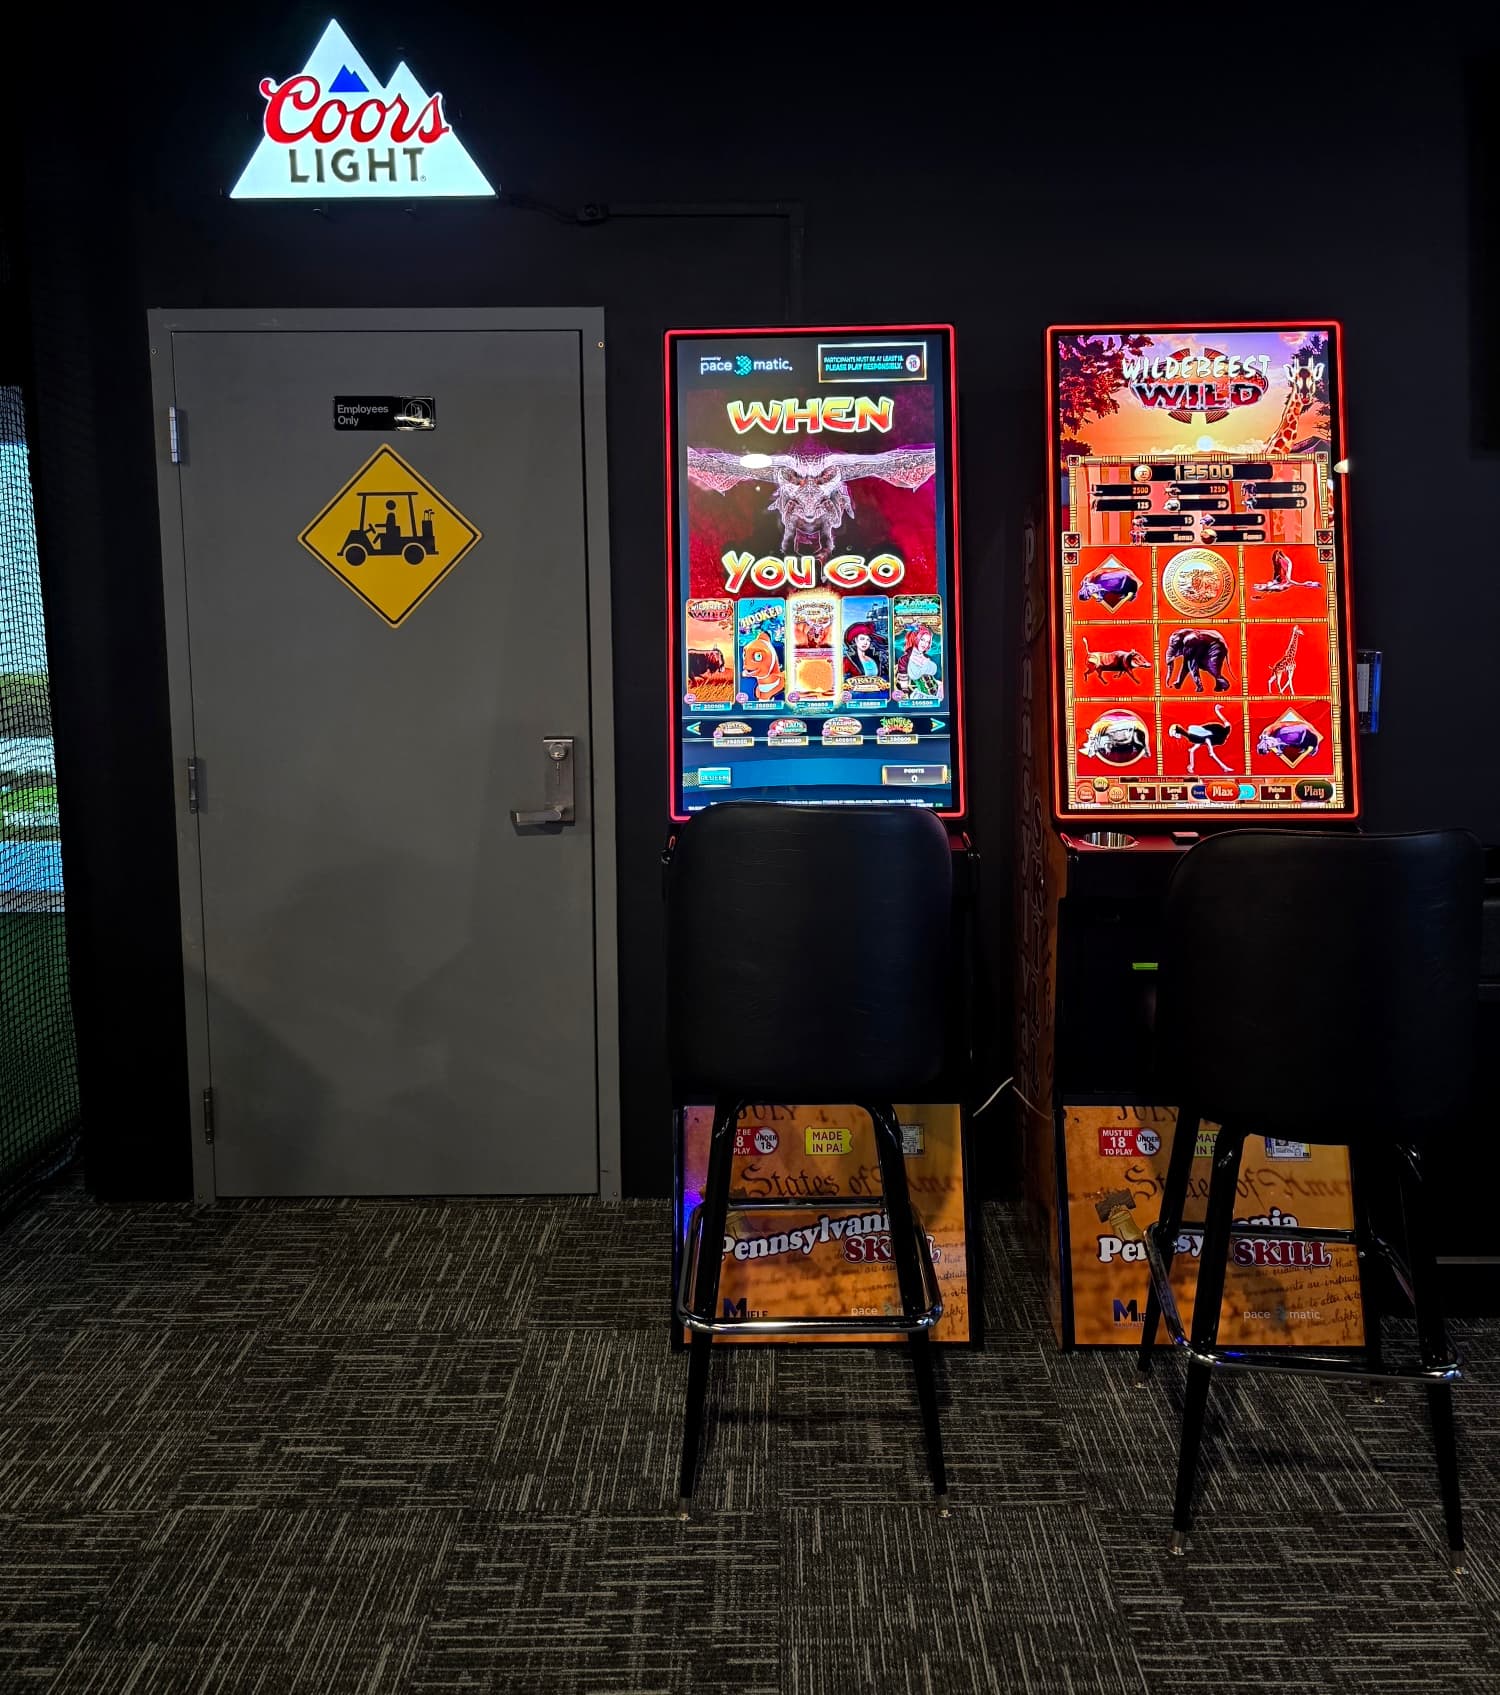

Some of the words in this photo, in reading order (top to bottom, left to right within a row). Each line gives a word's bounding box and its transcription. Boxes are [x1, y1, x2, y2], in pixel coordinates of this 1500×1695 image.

[259, 75, 450, 144] Coors
[288, 147, 425, 183] LIGHT
[701, 361, 732, 375] pace
[825, 363, 847, 371] PLEASE
[848, 362, 862, 370] PLAY
[1121, 354, 1271, 380] WILDEBEEST
[1132, 381, 1264, 409] WILD
[337, 404, 389, 415] Employees
[727, 397, 895, 434] WHEN
[337, 416, 359, 427] Only
[1173, 464, 1234, 480] 12500
[1132, 486, 1149, 494] 2500
[1210, 485, 1227, 493] 1250
[1291, 484, 1305, 492] 250
[1136, 501, 1150, 509] 125
[722, 551, 816, 594] YOU
[824, 554, 905, 588] GO
[740, 606, 783, 628] HOOKED
[911, 774, 918, 783] 0
[1212, 785, 1234, 796] Max
[1304, 785, 1325, 798] Play
[812, 1130, 843, 1141] MADE
[1136, 1136, 1160, 1144] UNDER
[1196, 1134, 1218, 1143] MAD
[761, 1141, 773, 1150] 18
[812, 1143, 822, 1153] IN
[826, 1143, 843, 1153] PA!
[1110, 1137, 1126, 1148] 18
[1142, 1143, 1154, 1151] 18
[1114, 1148, 1133, 1156] PLAY
[740, 1165, 840, 1197] States
[849, 1167, 872, 1196] of
[1232, 1239, 1332, 1266] SKILL
[850, 1307, 878, 1316] pace
[1243, 1311, 1271, 1322] pace
[1289, 1308, 1321, 1321] matic
